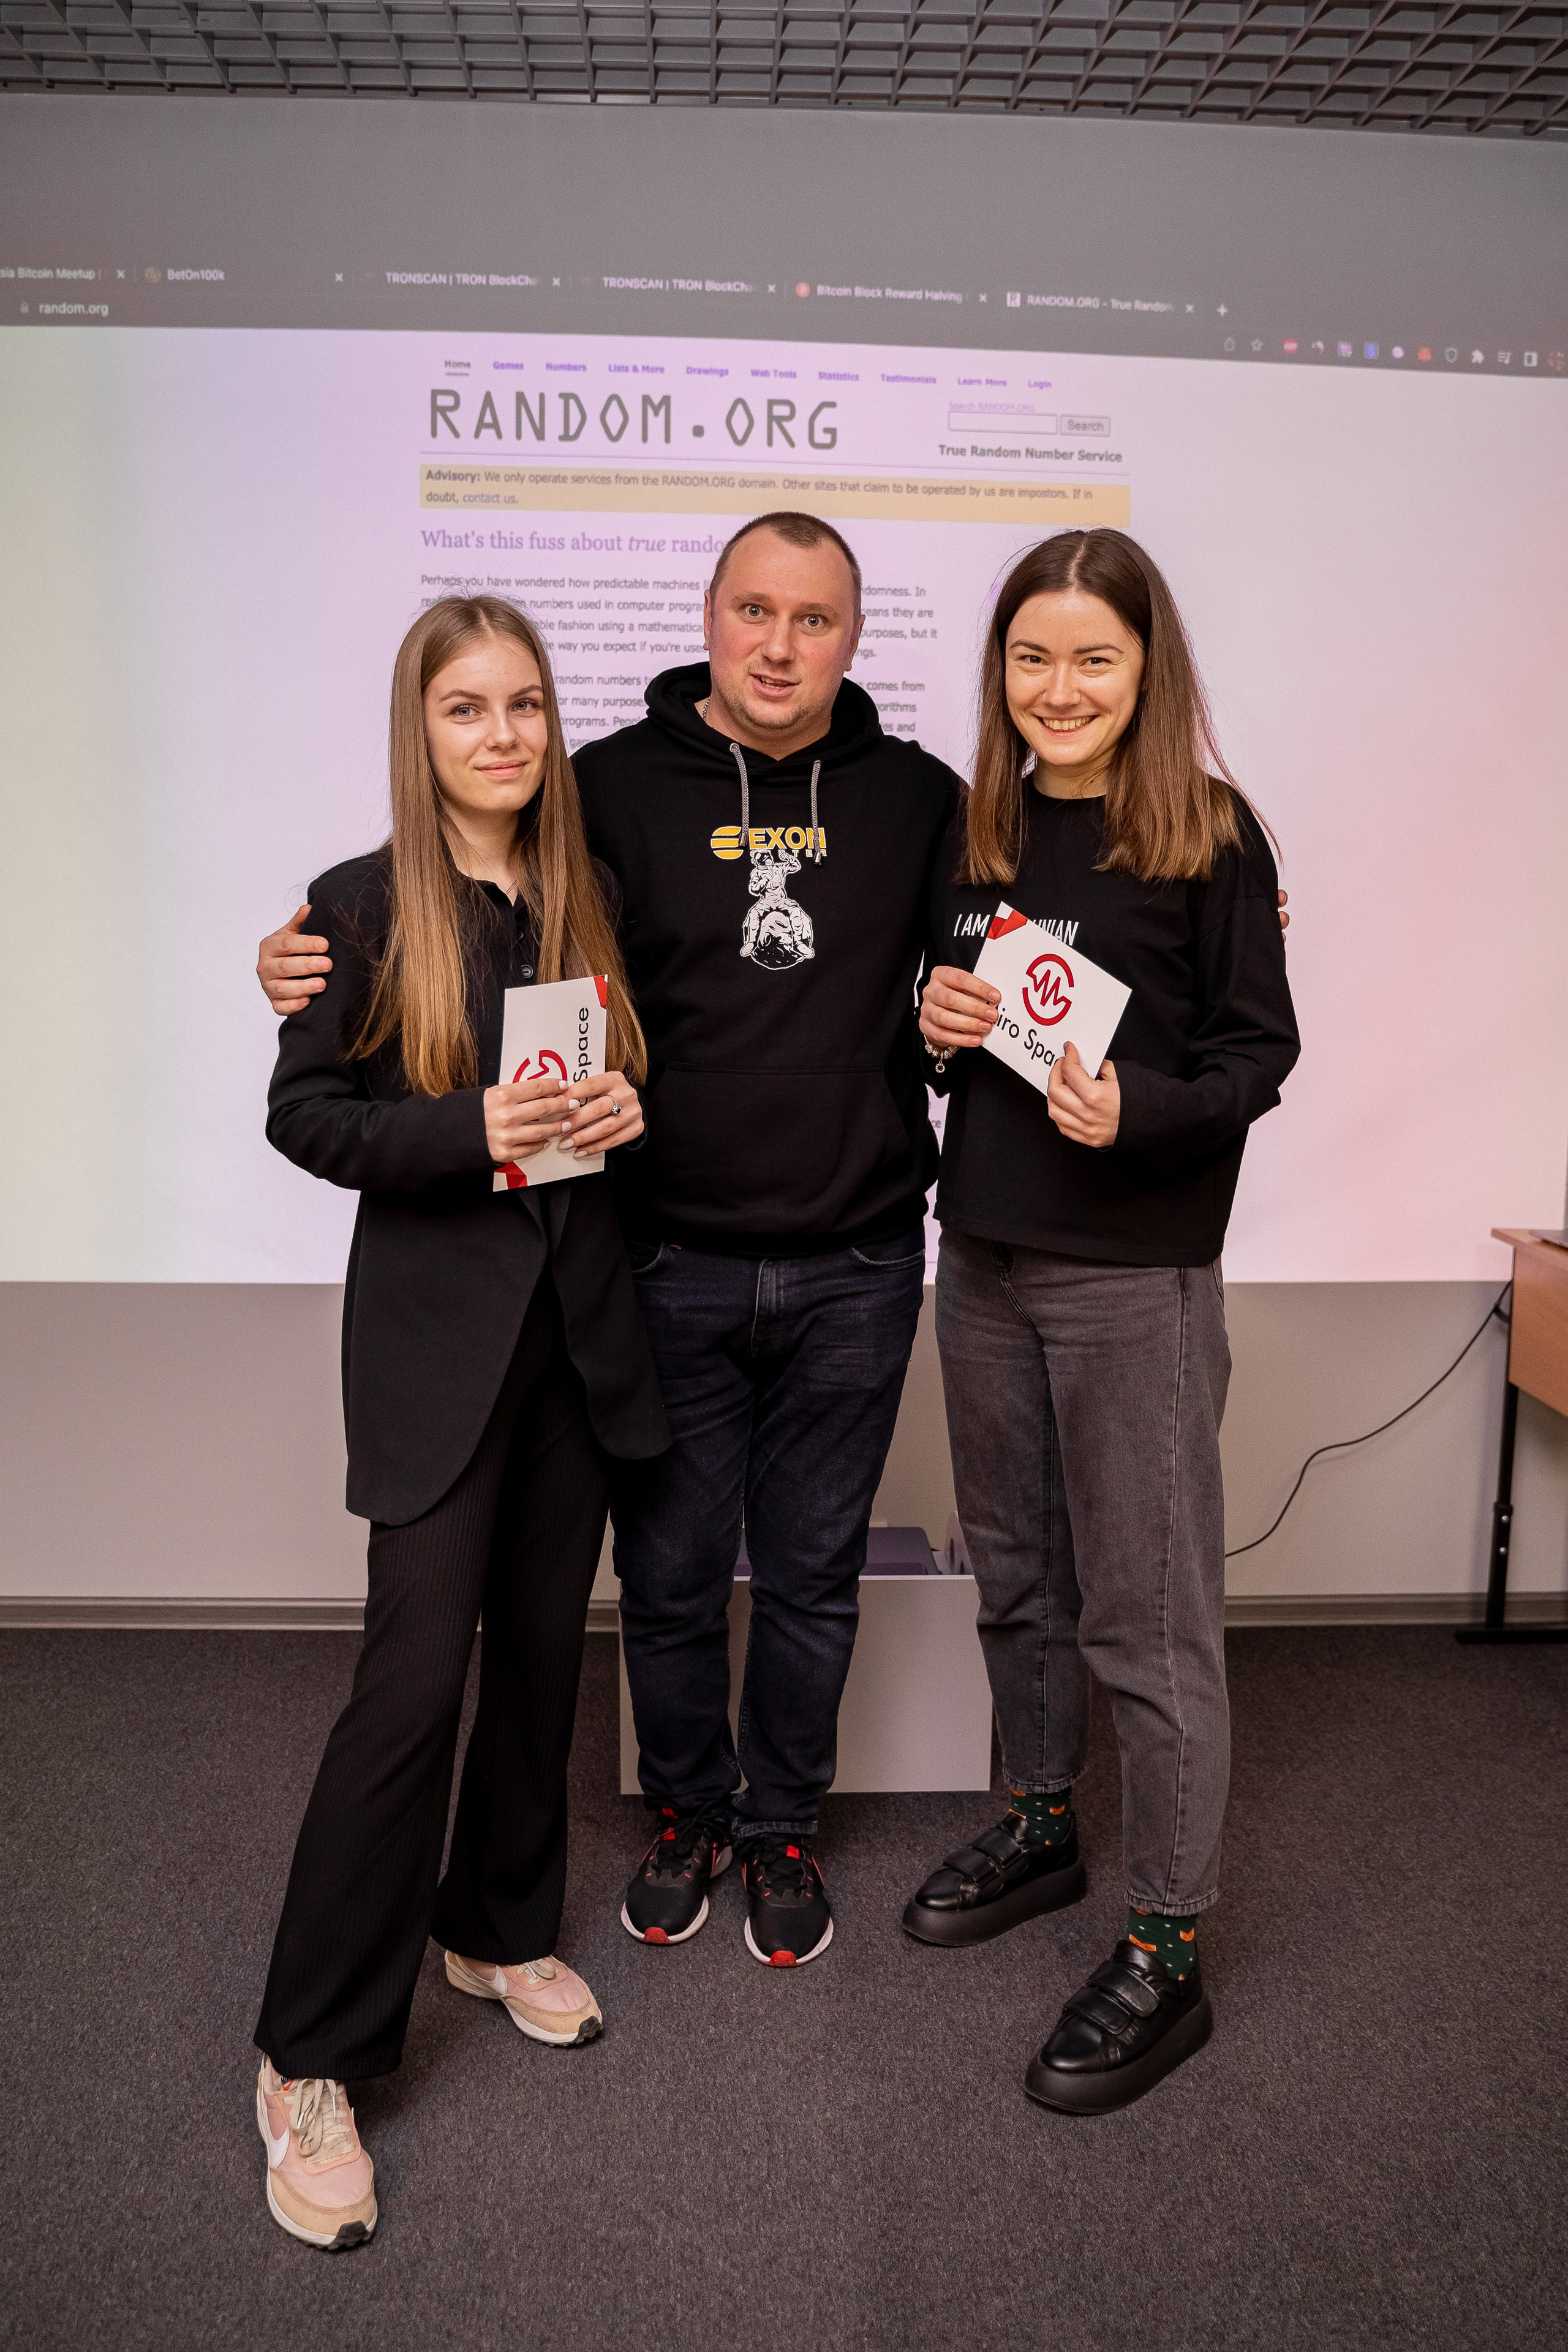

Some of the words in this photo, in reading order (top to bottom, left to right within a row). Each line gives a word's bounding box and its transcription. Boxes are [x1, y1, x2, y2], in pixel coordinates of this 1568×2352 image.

[17, 267, 53, 279] Bitcoin
[56, 268, 96, 280] Meetup
[167, 268, 225, 281] BetOn100k
[386, 272, 447, 284] TRONSCAN
[456, 273, 487, 285] TRON
[603, 277, 664, 289] TRONSCAN
[672, 279, 703, 290] TRON
[816, 285, 852, 296] Bitcoin
[854, 286, 883, 298] Block
[885, 287, 923, 300] Reward
[925, 290, 963, 304] Halving
[1027, 295, 1100, 309] RANDOM.ORG
[1110, 298, 1133, 311] True
[39, 303, 109, 317] random.org
[444, 360, 472, 369] Home
[492, 361, 524, 371] Games
[546, 363, 587, 372] Numbers
[608, 364, 630, 373] Lists
[641, 366, 665, 374] More
[685, 366, 729, 378] Drawings
[750, 369, 771, 378] Web
[773, 369, 797, 379] Tools
[818, 371, 860, 382] Statistics
[880, 373, 937, 384] Testimonials
[985, 378, 1008, 387] More
[1028, 380, 1052, 390] Login
[430, 388, 838, 450] RANDOM.ORG
[1067, 420, 1105, 431] Search
[938, 443, 967, 456] True
[970, 445, 1022, 458] Random
[1025, 447, 1075, 460] Number
[1077, 450, 1123, 462] Service
[426, 469, 481, 484] Advisory:
[484, 471, 501, 482] We
[503, 472, 526, 485] only
[528, 473, 568, 484] operate
[571, 475, 612, 485] services
[614, 474, 639, 485] from
[642, 475, 659, 485] the
[662, 475, 736, 488] RANDOM.ORG
[738, 478, 778, 489] domain.
[782, 478, 812, 491] Other
[814, 481, 837, 491] sites
[840, 481, 861, 492] that
[863, 482, 889, 492] claim
[892, 483, 903, 493] to
[906, 483, 919, 494] be
[921, 484, 967, 496] operated
[969, 485, 982, 498] by
[984, 488, 996, 497] us
[998, 488, 1016, 497] are
[1018, 488, 1069, 499] impostors.
[1072, 489, 1081, 499] If
[1083, 490, 1093, 500] in
[425, 491, 459, 505] doubt,
[462, 494, 500, 504] contact
[503, 496, 519, 505] us.
[420, 530, 484, 548] What's
[489, 531, 524, 549] this
[529, 532, 566, 550] fuss
[570, 532, 623, 551] about
[628, 536, 666, 552] true
[421, 575, 461, 589] Perhaps
[464, 577, 484, 589] you
[487, 576, 512, 587] have
[514, 577, 565, 588] wondered
[568, 578, 590, 588] how
[593, 578, 650, 590] predictable
[652, 580, 701, 590] machines
[915, 586, 926, 597] In
[529, 598, 575, 610] numbers
[577, 599, 602, 610] used
[605, 600, 614, 611] in
[617, 601, 665, 612] computer
[668, 603, 704, 614] progra
[892, 607, 914, 620] they
[917, 609, 934, 619] are
[557, 619, 595, 631] fashion
[598, 622, 625, 634] using
[628, 624, 635, 632] a
[911, 628, 928, 639] but
[930, 628, 938, 639] it
[558, 643, 578, 654] way
[581, 643, 600, 654] you
[603, 641, 637, 653] expect
[639, 641, 647, 652] if
[649, 641, 681, 654] you're
[556, 674, 594, 685] random
[597, 675, 642, 686] numbers
[866, 682, 899, 692] comes
[901, 680, 926, 692] from
[571, 697, 600, 709] many
[897, 722, 916, 733] and
[748, 826, 827, 850] EXON
[954, 913, 963, 937] I
[960, 913, 991, 938] AM
[573, 1006, 592, 1084] Space
[1023, 1028, 1058, 1067] Spa
